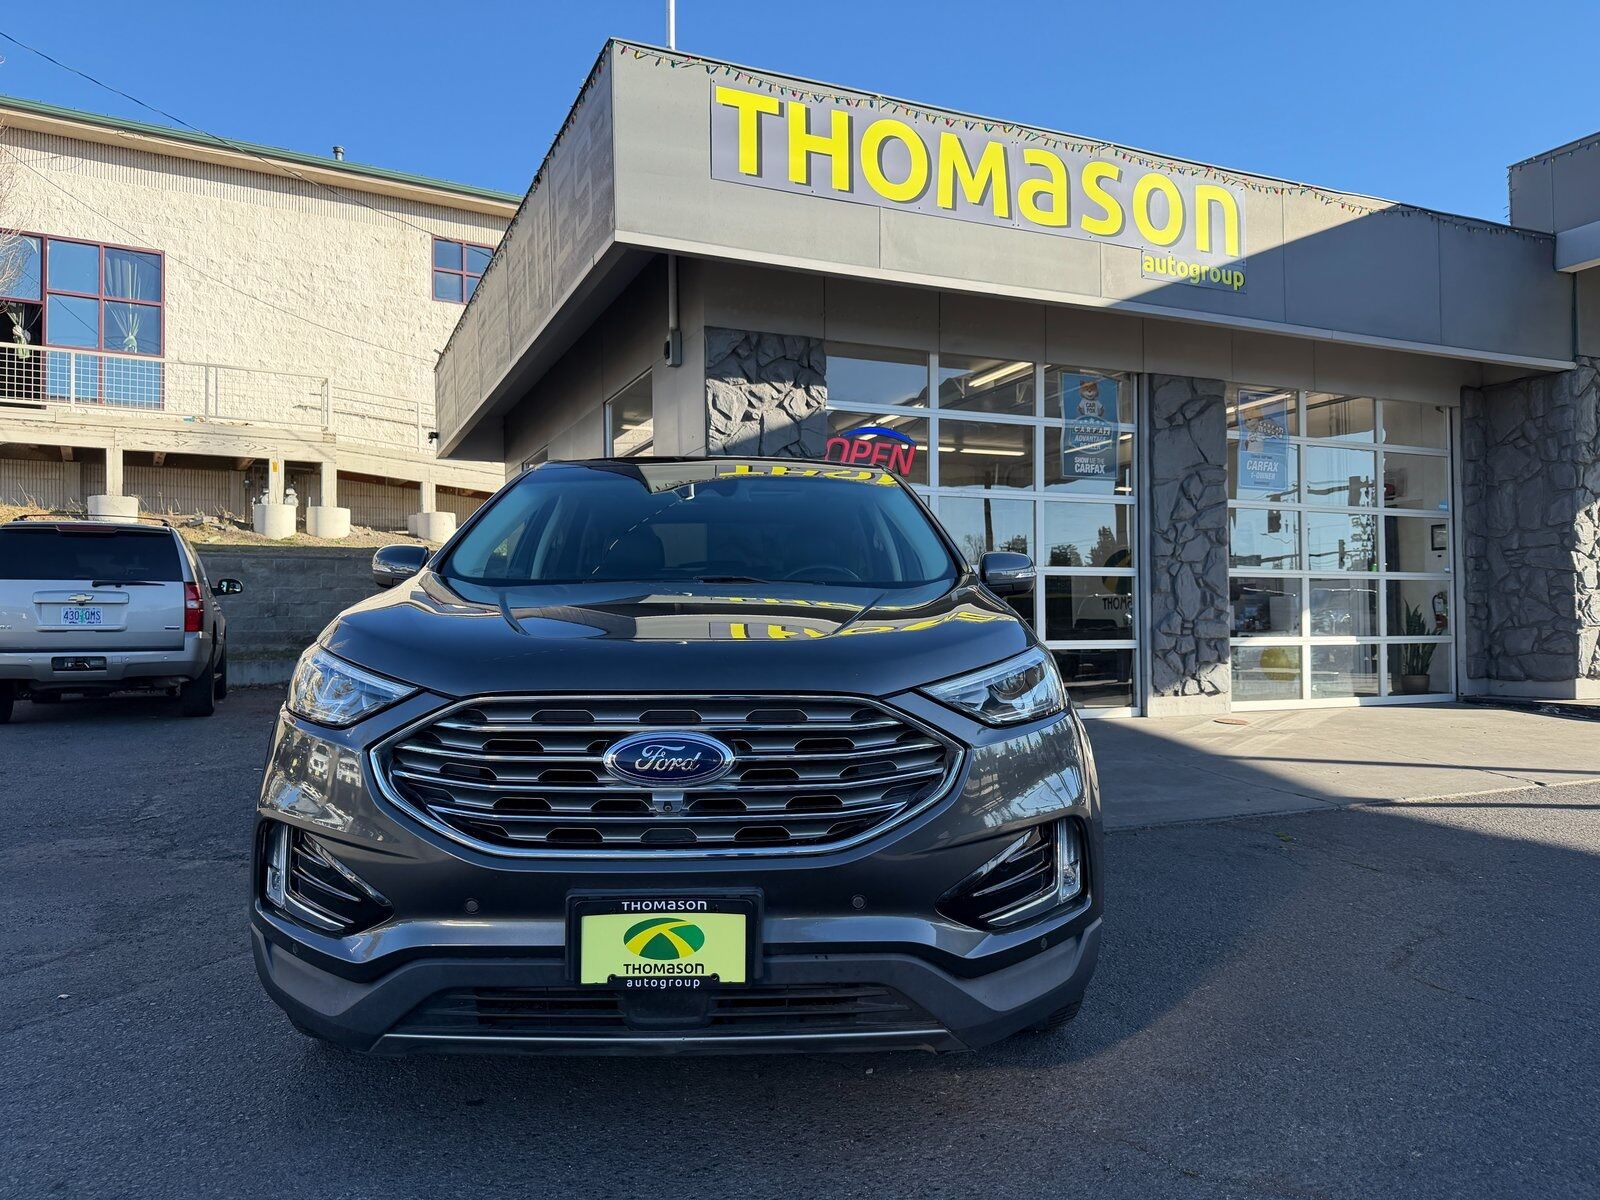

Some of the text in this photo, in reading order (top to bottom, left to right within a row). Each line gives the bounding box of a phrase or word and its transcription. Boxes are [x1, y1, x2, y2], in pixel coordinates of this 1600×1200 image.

[1142, 255, 1246, 291] autogroup
[824, 437, 917, 477] OPEN
[1246, 459, 1279, 472] CARFAX
[1074, 463, 1106, 475] CARFAX
[634, 743, 702, 772] Ford
[626, 978, 701, 989] autogroup
